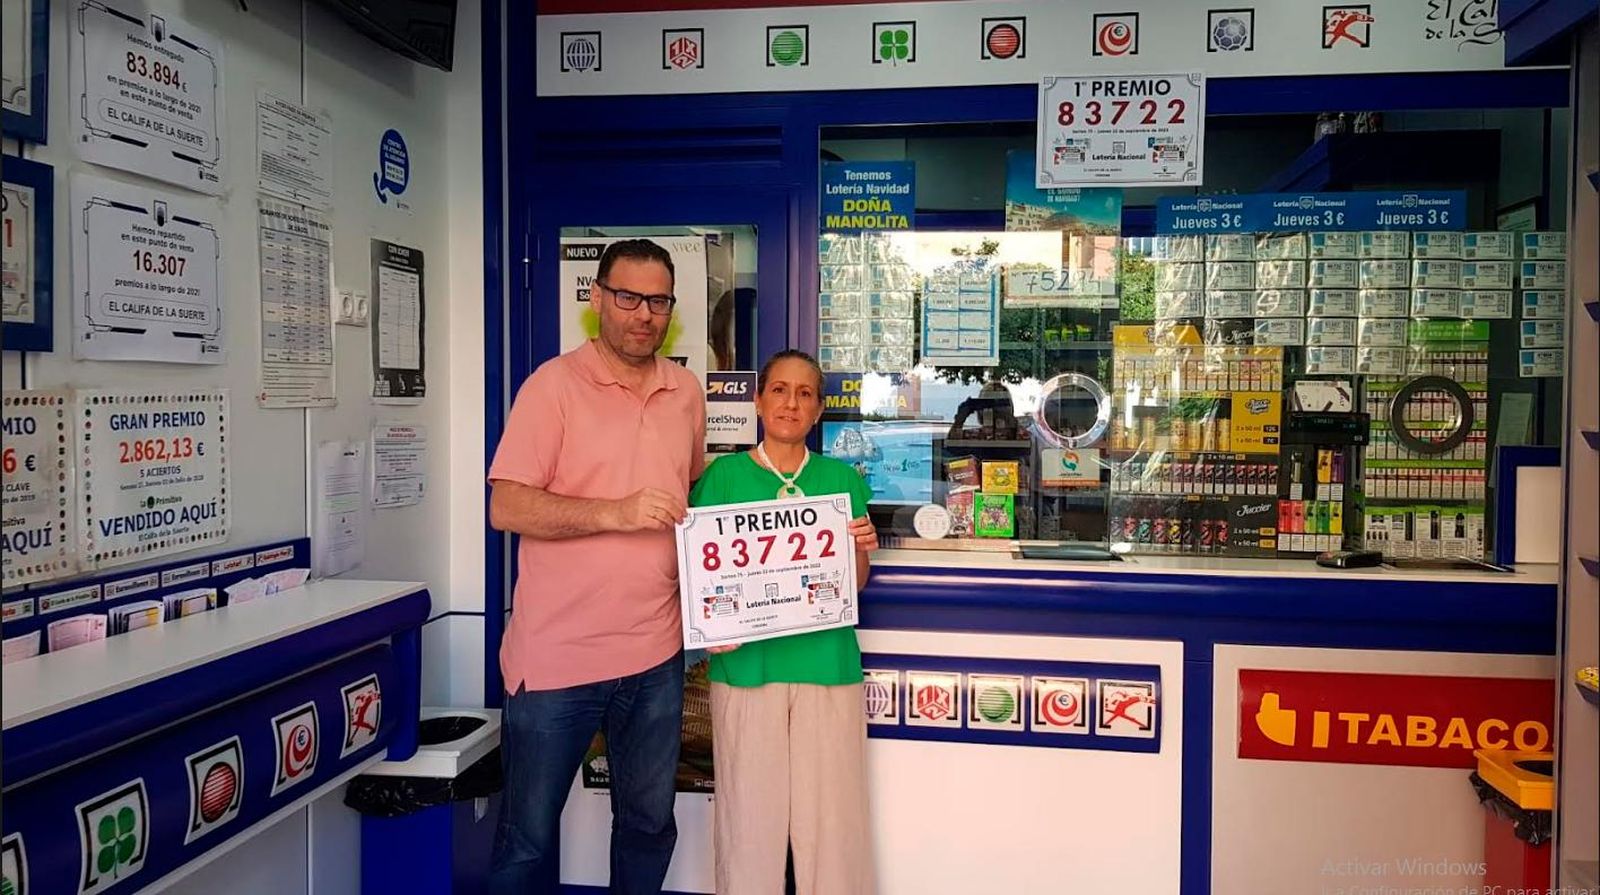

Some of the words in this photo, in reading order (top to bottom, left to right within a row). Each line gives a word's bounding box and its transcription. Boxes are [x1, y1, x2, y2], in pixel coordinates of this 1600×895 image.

[127, 33, 153, 49] Hemos
[126, 51, 180, 90] 83.894
[1092, 79, 1171, 97] PREMIO
[1058, 99, 1185, 126] 83722
[108, 107, 119, 120] EL
[121, 111, 152, 129] CALIFA
[153, 121, 165, 133] DE
[166, 126, 176, 138] LA
[177, 129, 204, 146] SUERTE
[1117, 153, 1146, 161] Nacional
[844, 170, 892, 181] Tenemos
[826, 183, 863, 194] Lotería
[866, 183, 910, 194] Navidad
[843, 196, 892, 212] DOÑA
[1171, 203, 1197, 211] Lotería
[1211, 202, 1243, 210] Nacional
[1273, 200, 1299, 208] Lotería
[1315, 199, 1346, 207] Nacional
[1418, 198, 1450, 206] Nacional
[826, 215, 909, 228] MANOLITA
[1172, 216, 1217, 229] Jueves
[1221, 213, 1230, 228] 3
[1233, 215, 1242, 227] €
[1274, 214, 1320, 227] Jueves
[1324, 210, 1333, 225] 3
[1336, 212, 1345, 225] €
[1376, 211, 1423, 225] Jueves
[1427, 209, 1437, 224] 3
[1440, 211, 1449, 224] €
[566, 247, 598, 258] NUEVO
[133, 249, 186, 277] 16.307
[109, 301, 120, 312] EL
[122, 303, 150, 315] CALIFA
[152, 306, 164, 316] DE
[166, 308, 176, 317] LA
[178, 309, 206, 321] SUERTE
[723, 381, 748, 394] GLS
[110, 413, 149, 431] GRAN
[153, 411, 206, 429] PREMIO
[119, 437, 193, 464] 2.862,13
[197, 442, 205, 457] €
[140, 469, 145, 478] 5
[146, 465, 182, 477] ACIERTOS
[6, 483, 31, 492] CLAVE
[99, 508, 175, 537] VENDIDO
[179, 498, 217, 525] AQUÍ
[735, 508, 817, 533] PREMIO
[702, 529, 836, 571] 83722
[746, 599, 770, 609] Lotería
[771, 595, 801, 606] Nacional
